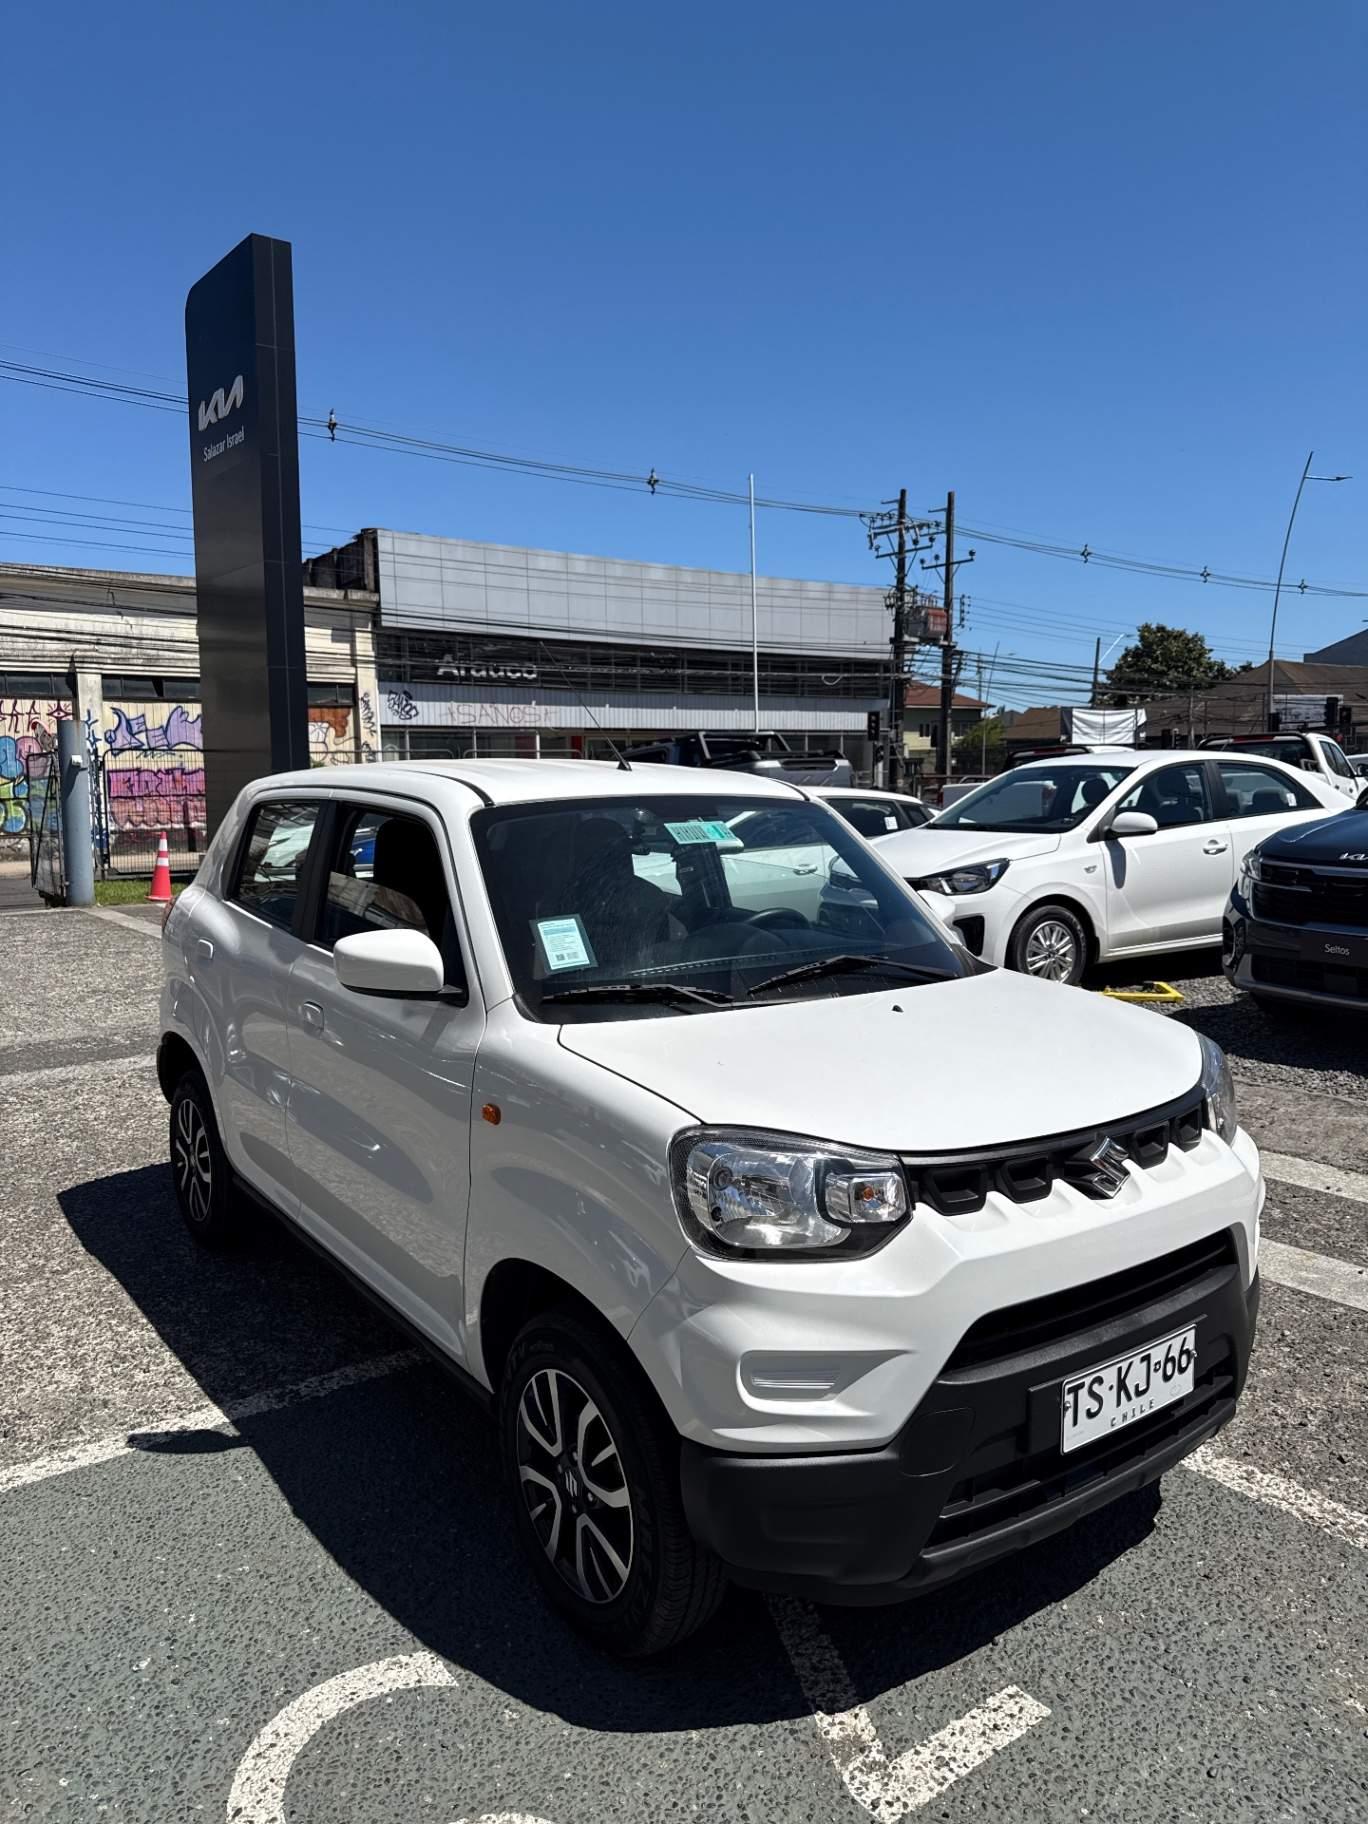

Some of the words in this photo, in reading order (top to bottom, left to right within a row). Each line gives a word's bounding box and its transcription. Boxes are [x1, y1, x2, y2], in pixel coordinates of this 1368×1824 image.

[198, 374, 244, 432] KIA
[203, 440, 226, 462] Salazar
[226, 424, 245, 449] Israel
[1324, 943, 1350, 956] Seltos
[1110, 1399, 1155, 1427] CHILE
